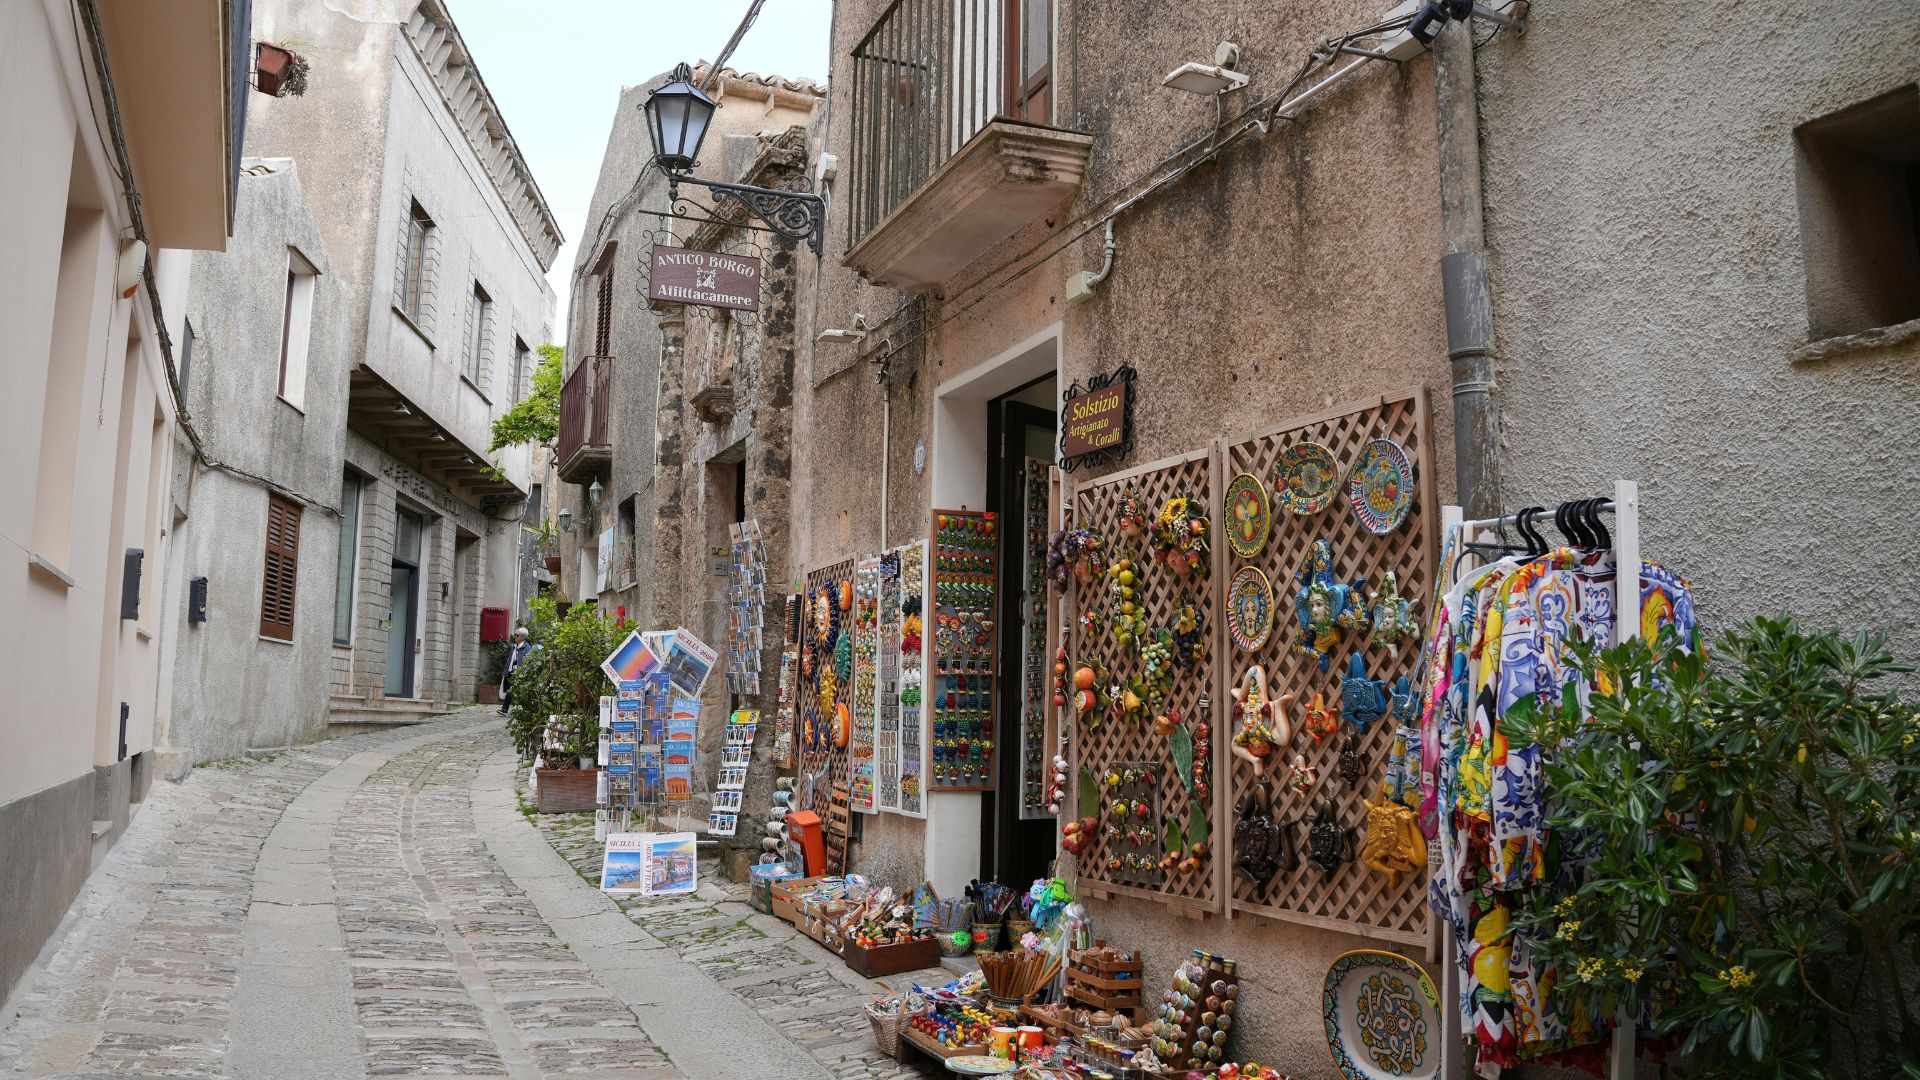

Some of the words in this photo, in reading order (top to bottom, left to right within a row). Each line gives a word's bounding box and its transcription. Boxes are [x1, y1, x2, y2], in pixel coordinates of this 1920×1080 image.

[658, 253, 704, 267] ANTICO
[709, 256, 755, 278] BORGO
[657, 284, 752, 306] Affittacamere
[1072, 391, 1119, 421] Solstizio
[1069, 418, 1109, 439] Artigianato
[1087, 435, 1094, 445] &
[1095, 428, 1120, 447] Coralli
[677, 632, 700, 652] SICILIA
[700, 649, 715, 663] 2026
